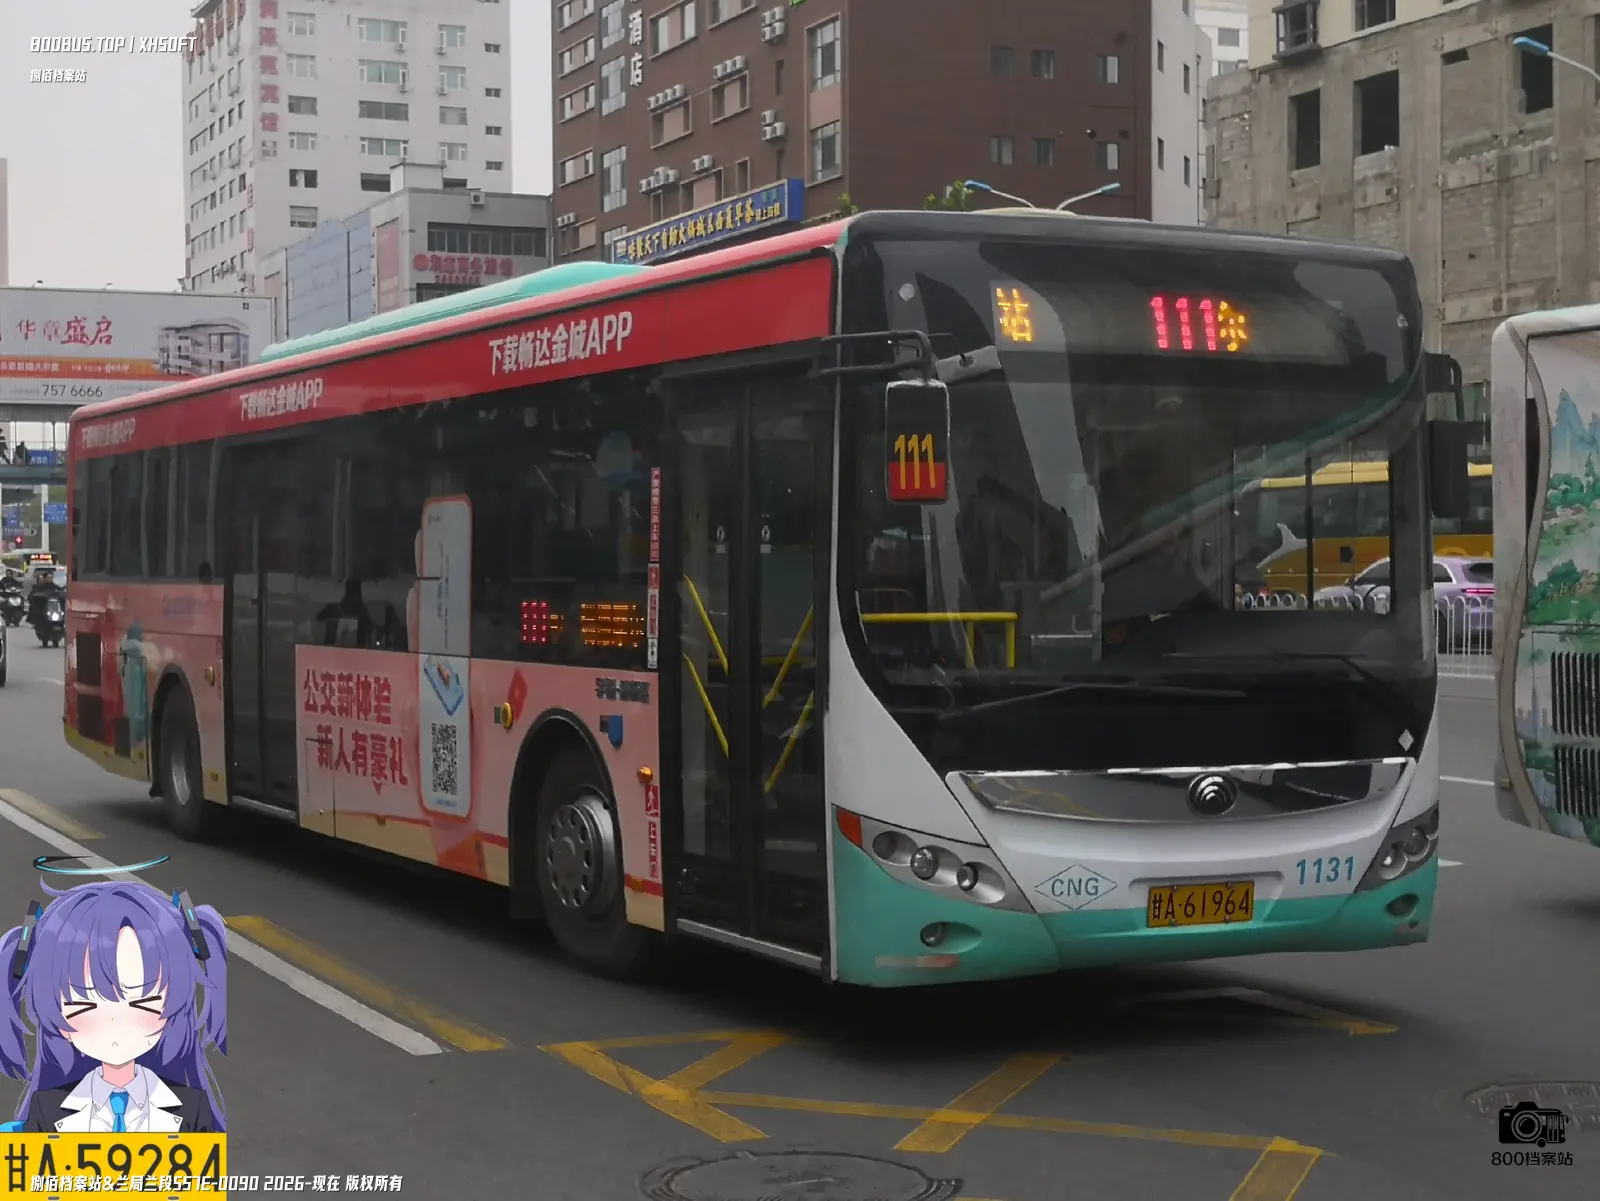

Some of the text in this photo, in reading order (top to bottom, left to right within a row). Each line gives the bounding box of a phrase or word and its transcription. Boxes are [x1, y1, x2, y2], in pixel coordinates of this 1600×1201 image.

[17, 316, 113, 347] 华盛启
[489, 311, 633, 376] 下载畅达金城APP
[42, 384, 66, 397] 757
[70, 385, 103, 397] 6666
[894, 433, 936, 490] 111
[303, 668, 392, 725] 公交新体验
[316, 724, 409, 786] 新人有豪礼
[1296, 856, 1355, 885] 1131
[1050, 877, 1100, 897] CNG
[1151, 887, 1250, 919] 甘A·61964
